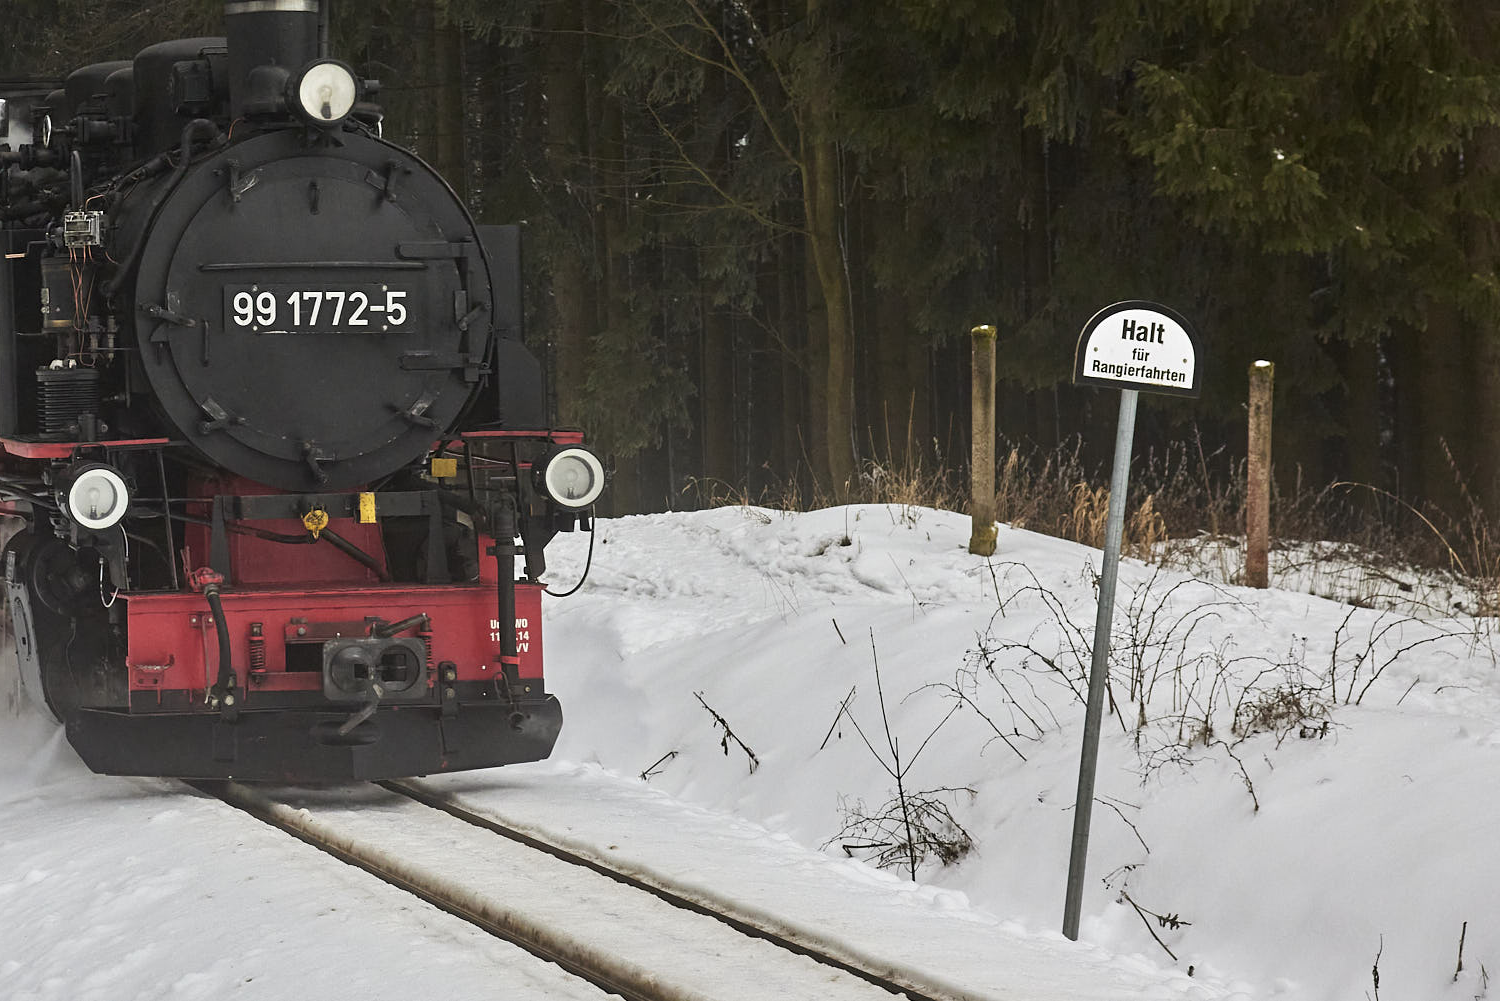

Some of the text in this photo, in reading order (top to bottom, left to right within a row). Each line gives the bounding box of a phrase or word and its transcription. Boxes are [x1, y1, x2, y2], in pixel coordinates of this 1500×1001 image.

[233, 291, 407, 326] 99 1772-5
[1121, 319, 1165, 344] Halt
[1132, 348, 1150, 362] für
[1092, 360, 1186, 382] Rangierfahrten
